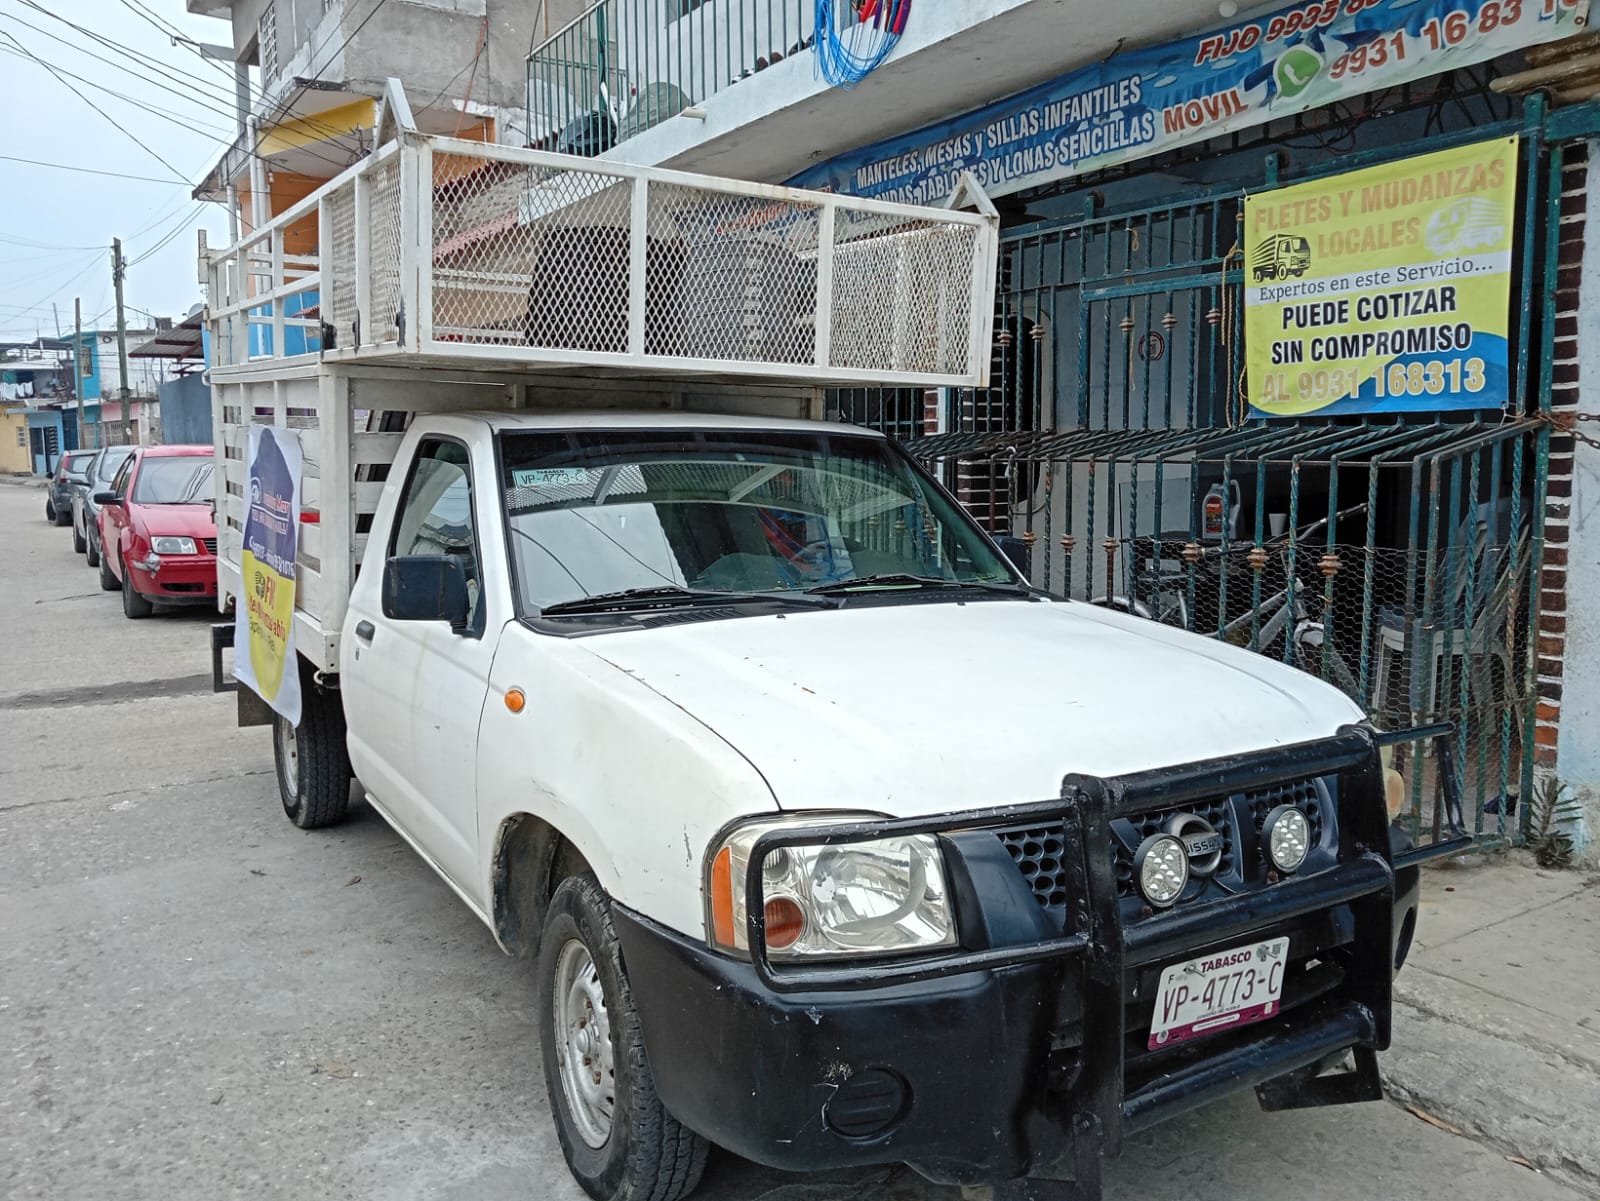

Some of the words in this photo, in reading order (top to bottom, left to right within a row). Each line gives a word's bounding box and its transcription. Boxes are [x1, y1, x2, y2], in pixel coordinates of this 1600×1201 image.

[1196, 26, 1260, 65] FIJO
[1266, 0, 1341, 42] 9935
[1163, 89, 1249, 135] MOVIL
[1330, 31, 1406, 79] 9931
[1423, 13, 1467, 50] 16
[1478, 0, 1522, 33] 83
[856, 151, 922, 190] MANTELES,
[925, 131, 973, 168] MESAS
[974, 132, 984, 157] y
[987, 109, 1041, 148] SILLAS
[1044, 75, 1142, 131] INFANTILES
[919, 161, 987, 202] TABLOES
[991, 158, 1004, 182] Y
[1005, 143, 1055, 179] LONAS
[1058, 112, 1154, 163] SENCILLAS
[1254, 194, 1331, 234] FLETES
[1338, 190, 1356, 217] Y
[1361, 159, 1505, 213] MUDANZAS
[1318, 217, 1421, 259] LOCALES
[1260, 280, 1325, 302] Expertos
[1330, 279, 1350, 291] en
[1355, 270, 1391, 288] este
[1397, 257, 1493, 282] Servicio...
[1282, 300, 1349, 330] PUEDE
[1356, 286, 1457, 322] COTIZAR
[1271, 339, 1304, 366] SIN
[1311, 322, 1472, 362] COMPROMISO
[1263, 373, 1290, 402] AL
[1299, 366, 1360, 400] 9931
[1372, 357, 1486, 398] 168313
[1201, 951, 1252, 974] TABASCO
[1162, 961, 1282, 1025] VP-4773-C
